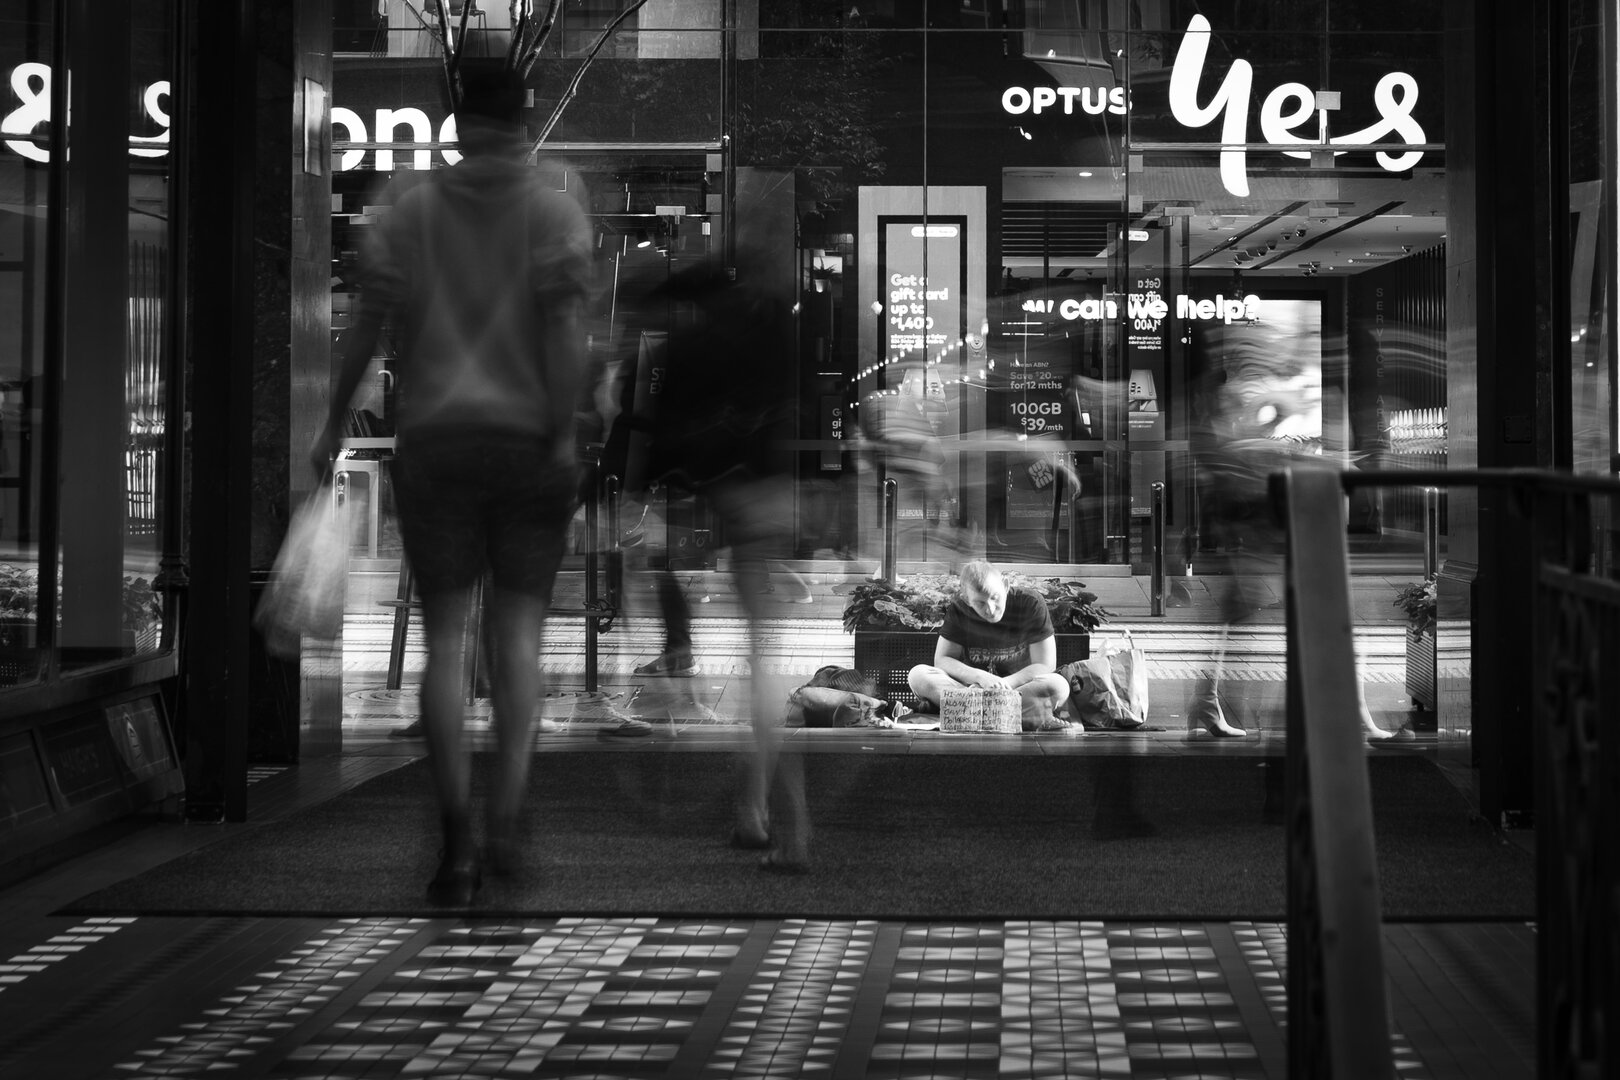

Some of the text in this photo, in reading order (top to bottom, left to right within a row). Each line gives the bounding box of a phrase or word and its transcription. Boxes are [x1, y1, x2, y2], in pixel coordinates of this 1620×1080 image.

[1001, 86, 1133, 115] OPTUS
[890, 273, 917, 286] Get
[890, 287, 949, 303] gift card
[890, 304, 909, 317] up
[1059, 299, 1118, 320] can
[1127, 299, 1169, 320] we
[1176, 294, 1260, 325] help?
[890, 316, 934, 331] $1,400
[1375, 287, 1384, 378] SERVICE
[1009, 371, 1033, 380] Save
[1010, 380, 1062, 390] for 12 mths
[1010, 402, 1062, 415] 100GB
[1020, 417, 1064, 431] $39/mth
